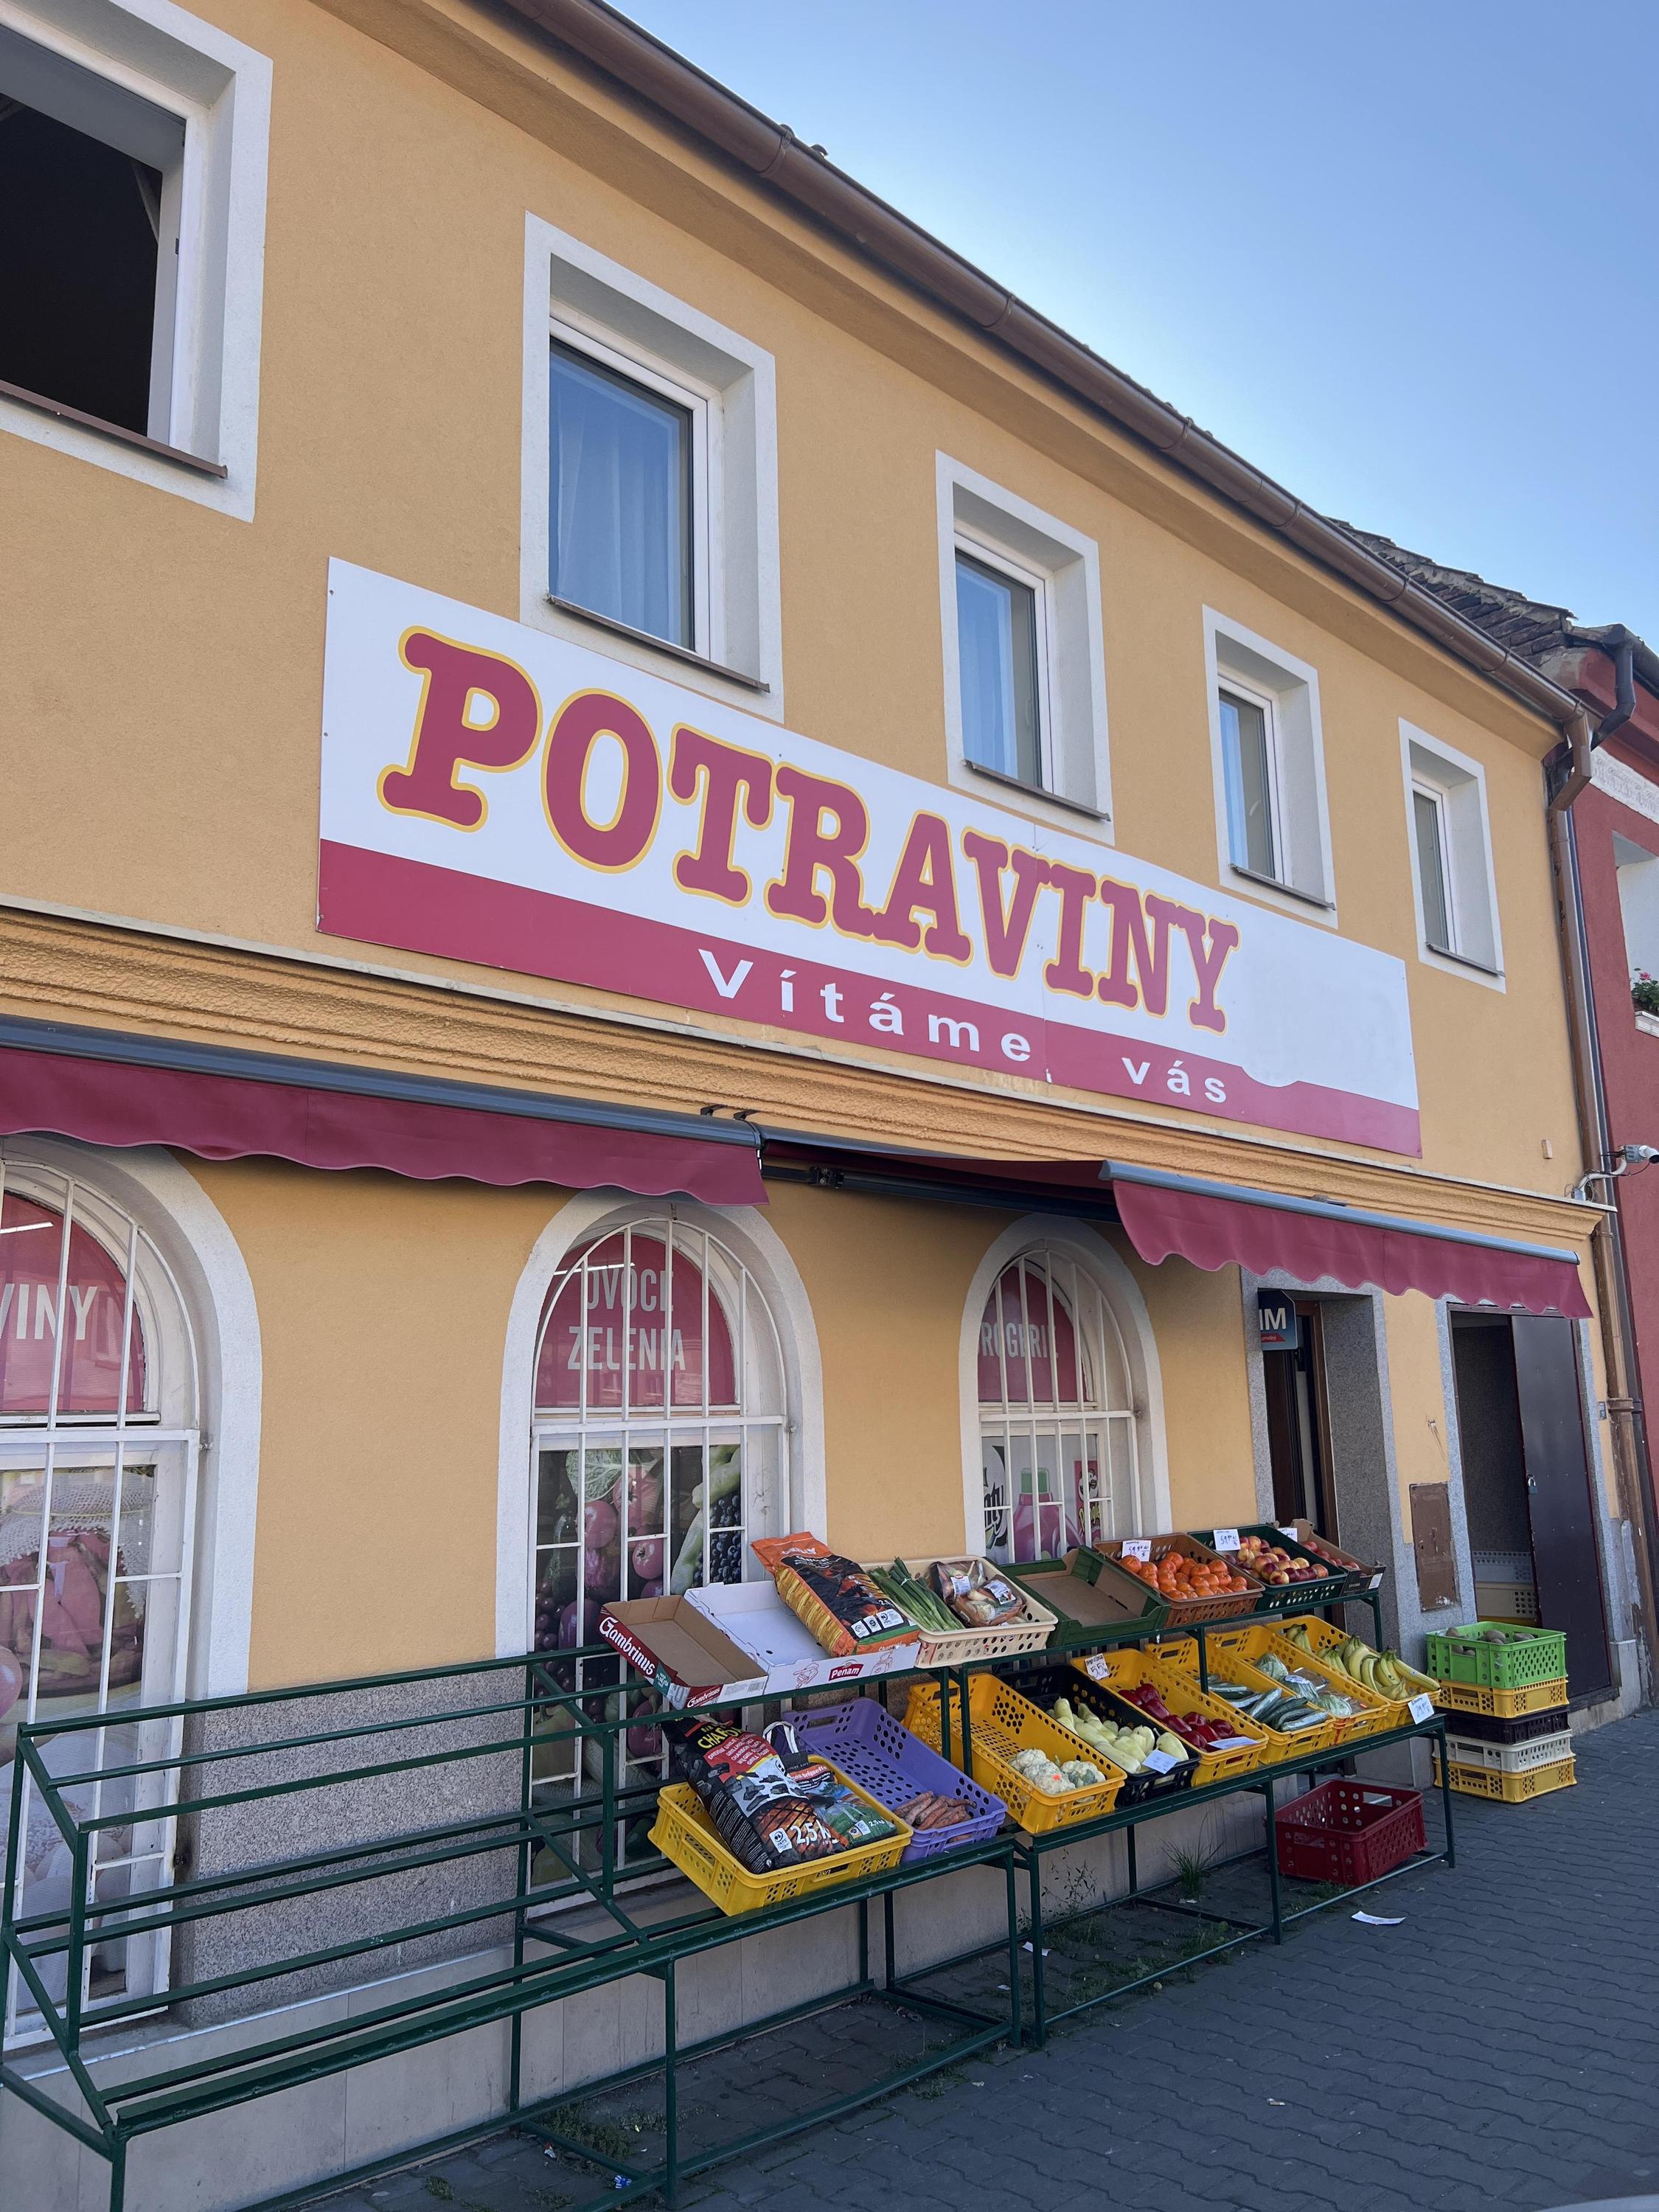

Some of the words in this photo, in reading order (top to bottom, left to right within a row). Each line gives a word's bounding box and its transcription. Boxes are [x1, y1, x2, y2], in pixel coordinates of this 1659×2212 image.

[378, 625, 1240, 1036] POTRAVINY
[698, 948, 1031, 1062] Vítáme
[1121, 1057, 1227, 1103] vás
[599, 1616, 656, 1676] Gambrinus
[830, 1667, 860, 1679] Penam
[686, 1687, 721, 1708] Gambrinus
